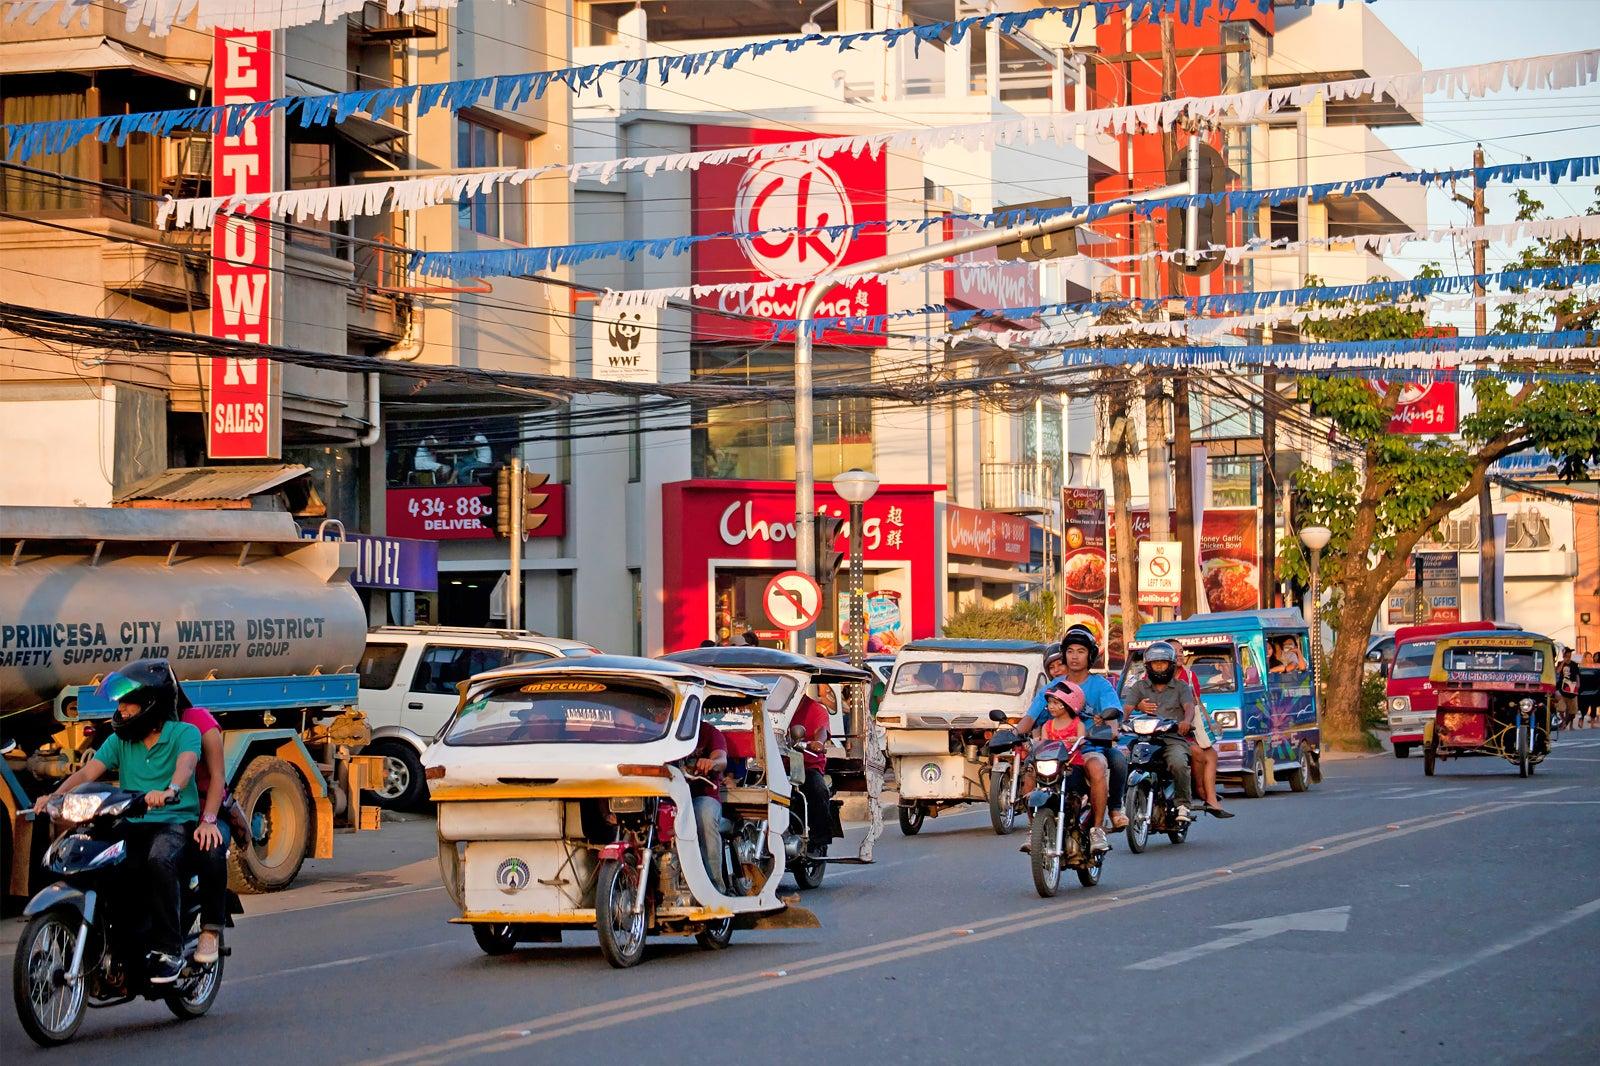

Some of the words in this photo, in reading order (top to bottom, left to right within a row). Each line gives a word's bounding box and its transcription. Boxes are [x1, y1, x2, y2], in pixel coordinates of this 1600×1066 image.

[719, 287, 851, 327] Chowng
[608, 355, 641, 367] WWF
[215, 403, 264, 433] SALES
[1391, 405, 1434, 424] wking
[424, 518, 487, 530] DELIVER
[1200, 535, 1219, 543] Honey
[1223, 534, 1242, 542] Garlic
[1156, 546, 1164, 554] NO
[356, 539, 399, 585] LOPEZ
[1148, 578, 1158, 587] LEFT
[1159, 578, 1171, 587] TURN
[1139, 594, 1170, 602] Jollibee
[1434, 597, 1456, 606] OFFICE
[1434, 611, 1456, 619] ACL
[2, 622, 107, 648] PRINCESA
[120, 621, 161, 644] CITY
[176, 620, 235, 642] WATER
[247, 617, 325, 640] DISTRICT
[63, 647, 133, 666] SUPPORT
[177, 643, 240, 660] DELIVERY
[246, 641, 290, 658] GROUP.
[527, 683, 598, 691] mercury
